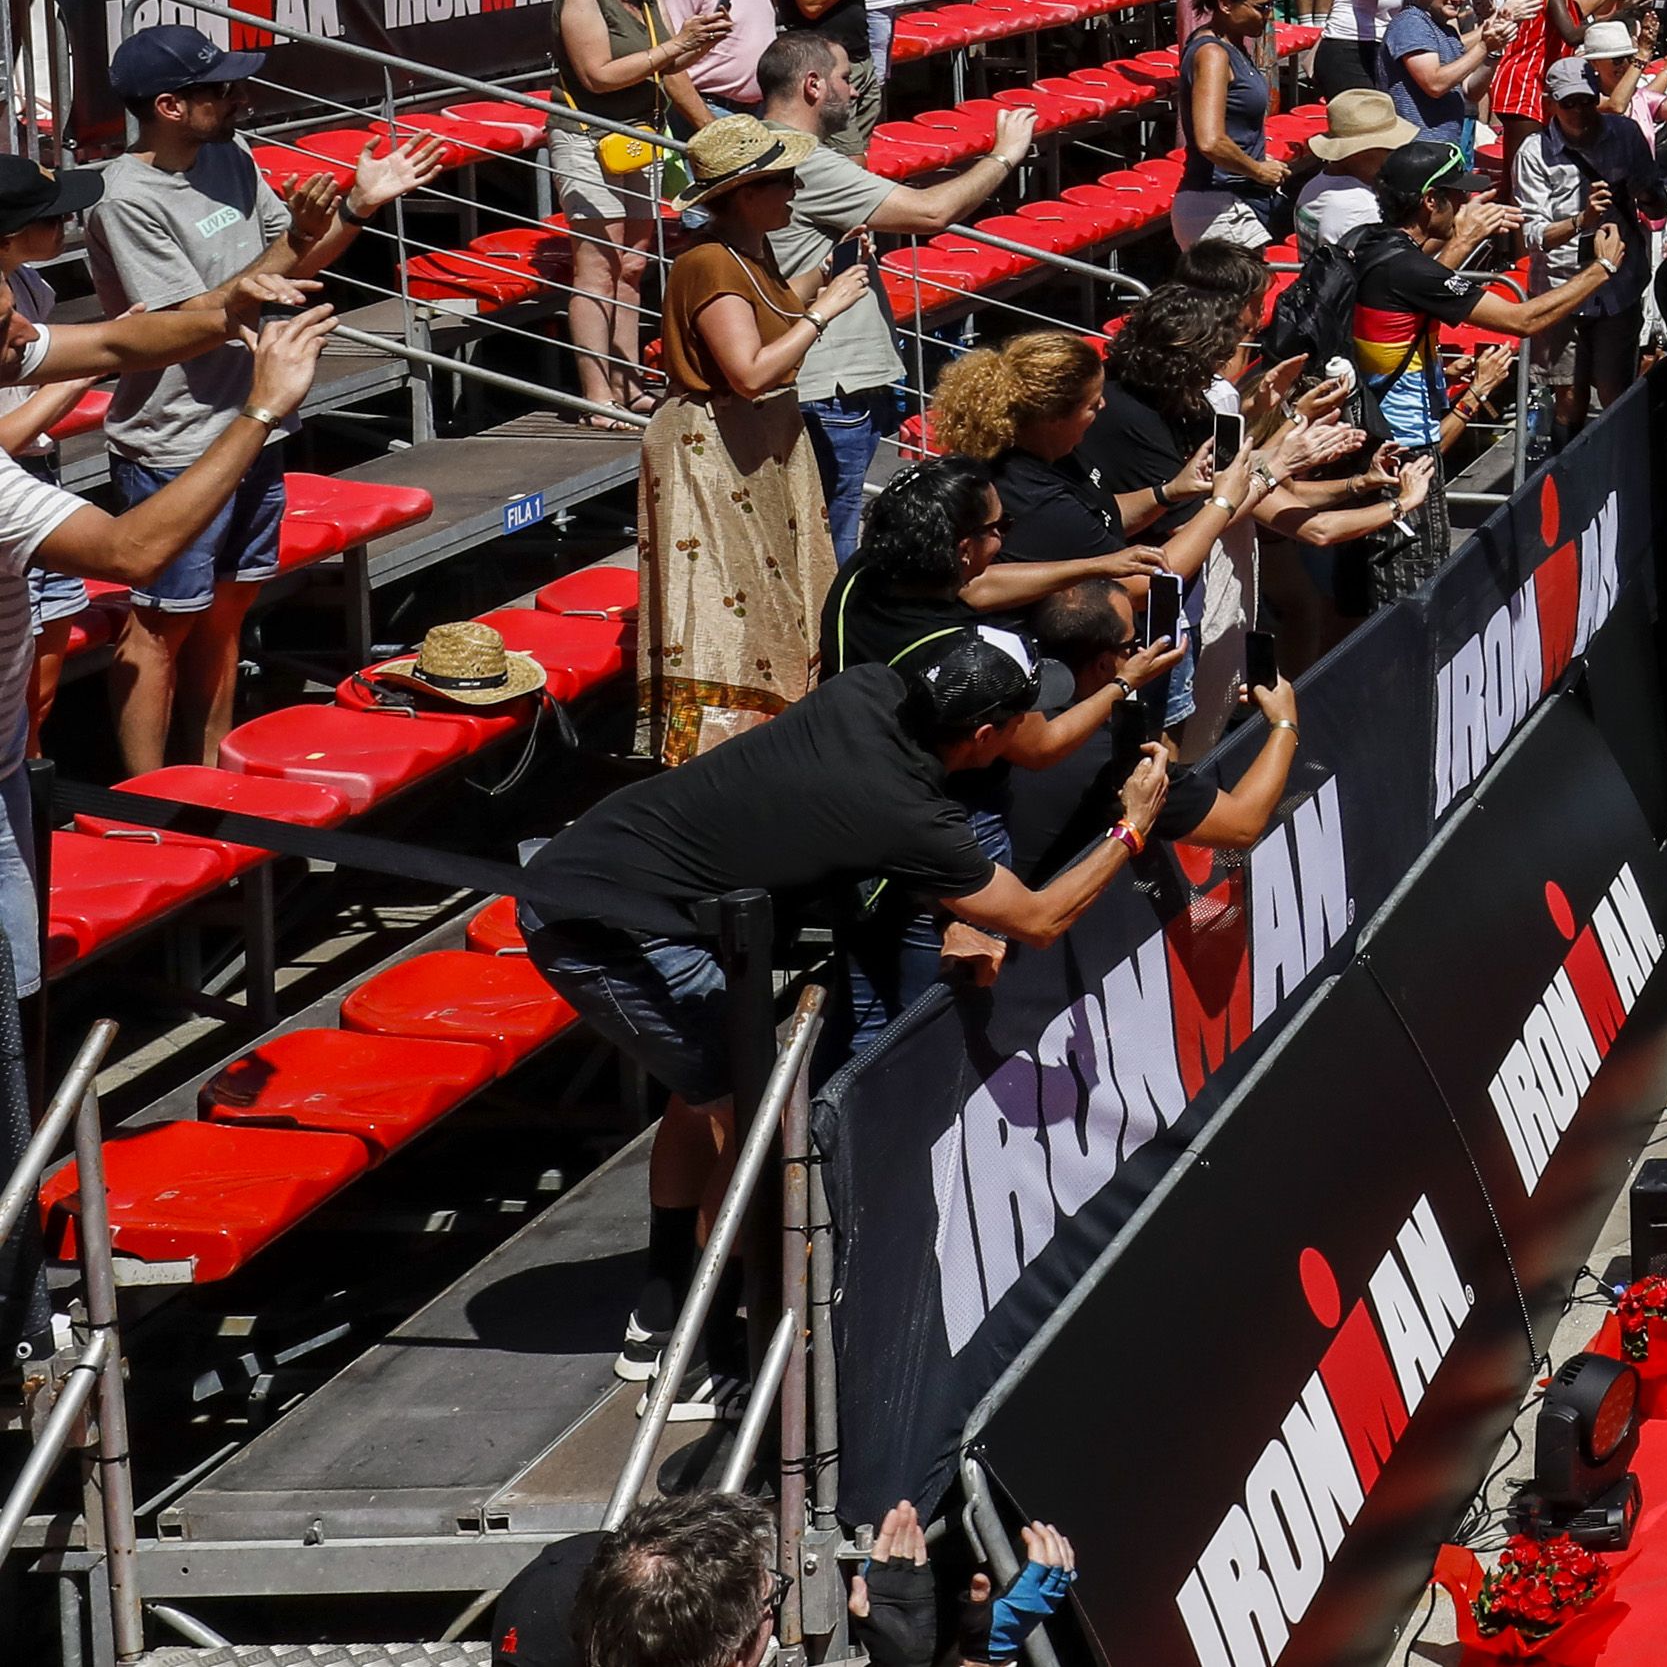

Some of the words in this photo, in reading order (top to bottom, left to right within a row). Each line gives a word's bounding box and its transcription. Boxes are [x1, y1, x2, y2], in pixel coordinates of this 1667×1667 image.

[508, 501, 533, 529] FILA
[1435, 475, 1622, 820] IRONMAN
[931, 776, 1347, 1357] IRONMAN
[1489, 861, 1662, 1197] IRONMAN
[1176, 1193, 1469, 1667] IRONMAN
